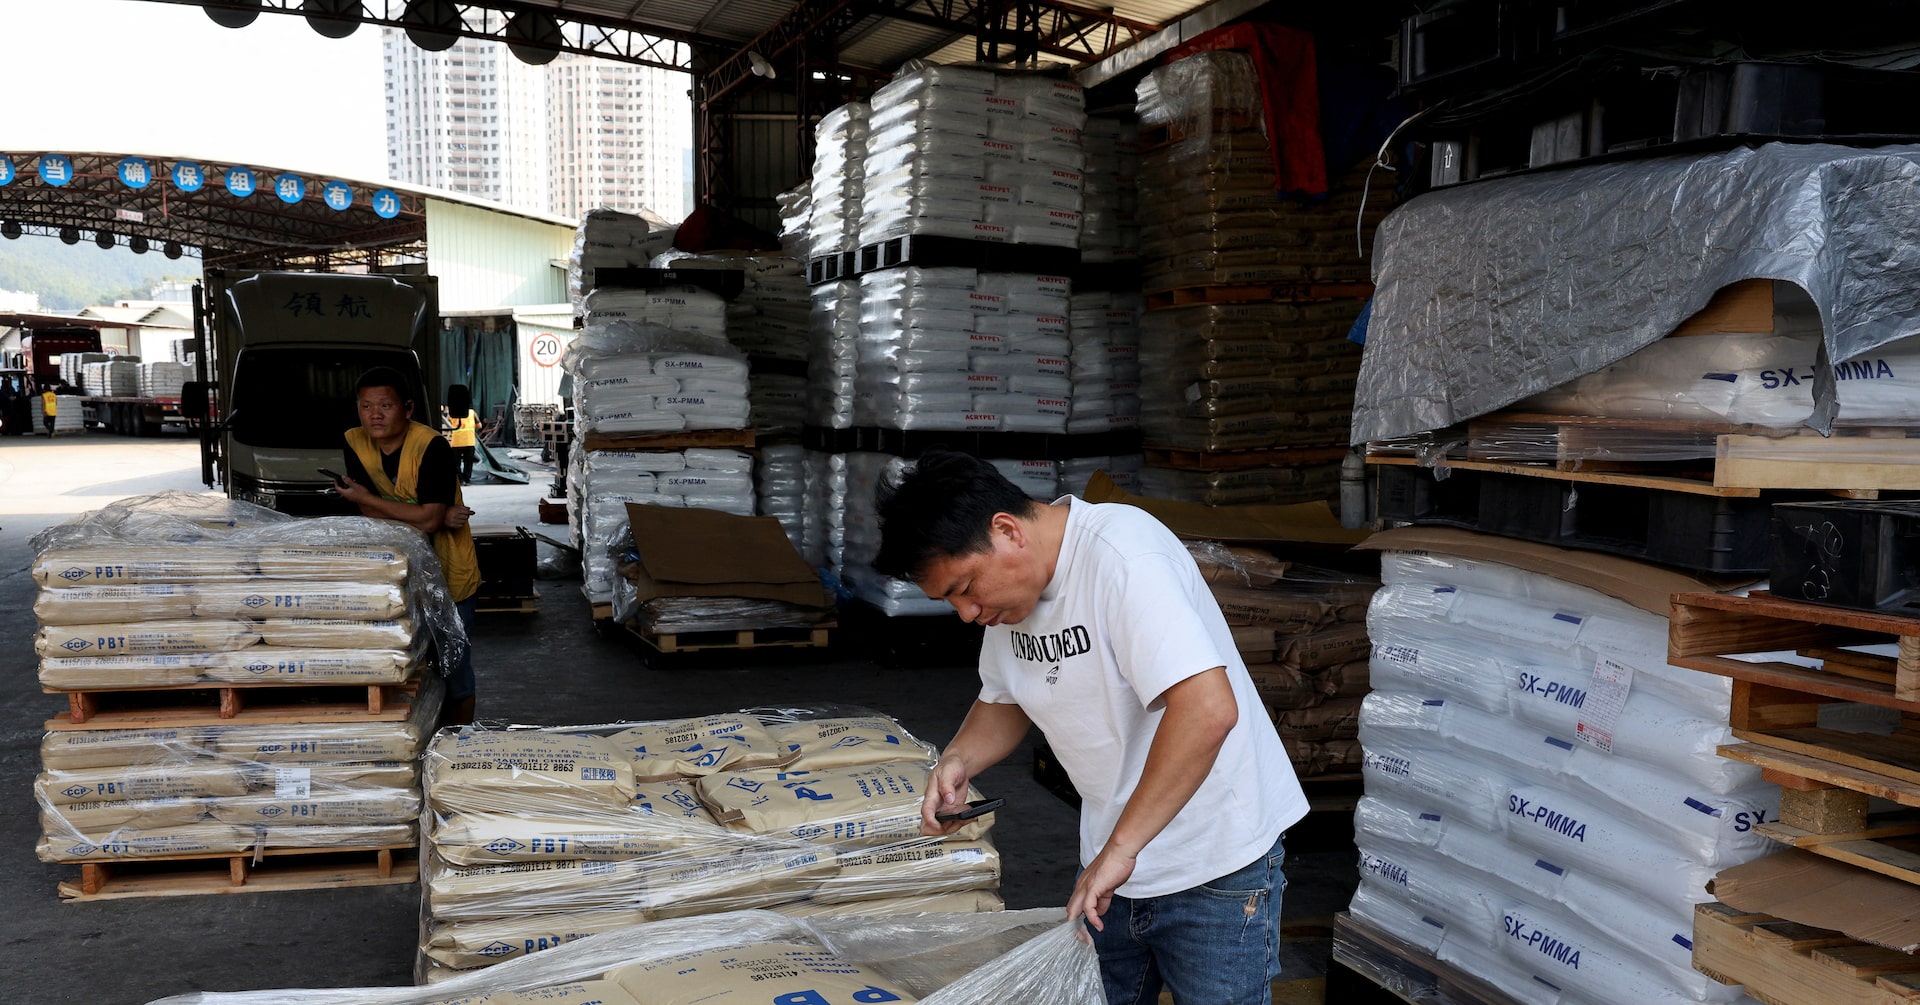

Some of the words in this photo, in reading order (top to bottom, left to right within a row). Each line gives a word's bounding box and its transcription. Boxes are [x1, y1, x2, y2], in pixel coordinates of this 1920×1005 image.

[985, 97, 1015, 106] ACRYPET
[984, 141, 1013, 151] ACRYPET
[1053, 170, 1080, 181] ACRYPET
[980, 184, 1010, 193] ACRYPET
[1050, 211, 1079, 221] ACRYPET
[975, 224, 1004, 233] ACRYPET
[1037, 276, 1066, 285] ACRYPET
[970, 293, 1000, 302] ACRYPET
[1037, 317, 1065, 326] ACRYPET
[970, 334, 1000, 343] ACRYPET
[537, 340, 557, 355] 20
[665, 361, 703, 369] SX-PMMA
[1037, 358, 1066, 366] ACRYPET
[1760, 359, 1894, 389] SX-MMA
[590, 378, 629, 388] SX-PMMA
[667, 398, 704, 406] SX-PMMA
[1037, 399, 1066, 408] ACRYPET
[594, 413, 633, 422] SX-PMMA
[65, 571, 84, 579] CCP
[95, 566, 124, 579] PBT
[275, 595, 303, 608] PBT
[67, 641, 87, 650] CCP
[97, 637, 125, 650] PBT
[278, 661, 305, 674] PBT
[1519, 672, 1587, 709] SX-PMM
[709, 723, 744, 736] GRADE
[665, 732, 699, 745] 4130218S
[290, 741, 318, 753] PBT
[451, 762, 493, 771] 4130218S
[66, 788, 87, 796] CCP
[97, 782, 125, 795] PBT
[291, 804, 318, 816] PBT
[1508, 794, 1587, 843] SX-PMMA
[834, 822, 868, 839] PBT
[490, 841, 517, 851] CCP
[532, 838, 569, 853] PBT
[484, 947, 511, 957] CCP
[525, 936, 561, 955] PBT
[1503, 914, 1581, 970] SX-PMMA
[747, 963, 790, 972] NATURAL
[750, 970, 798, 981] 4115218S
